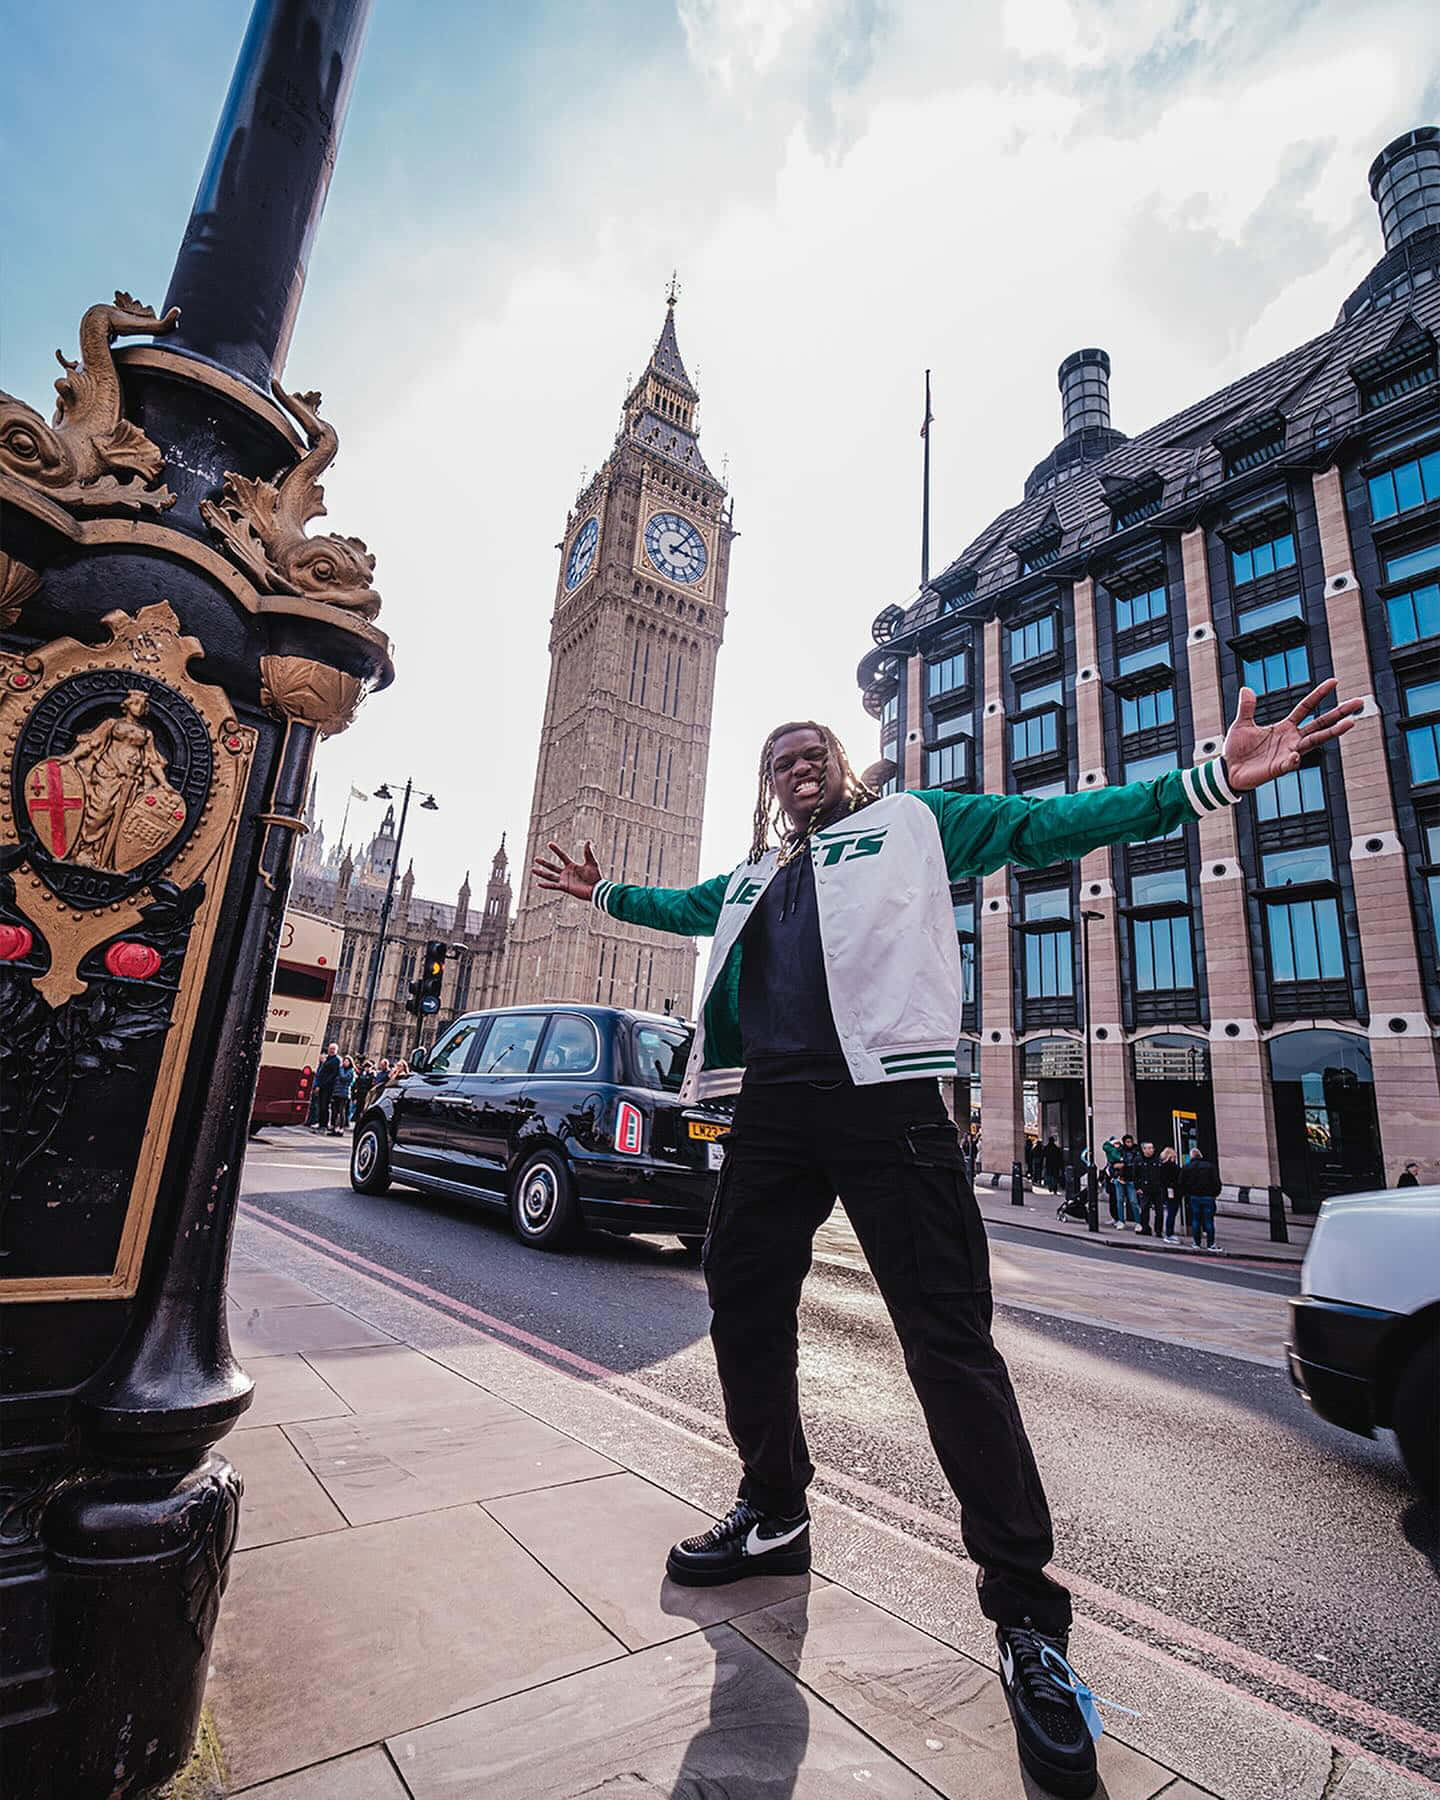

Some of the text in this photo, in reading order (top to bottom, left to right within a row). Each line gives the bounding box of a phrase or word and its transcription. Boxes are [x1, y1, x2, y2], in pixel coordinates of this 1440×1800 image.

[24, 673, 208, 798] LONDON COUNTY COUNCIL
